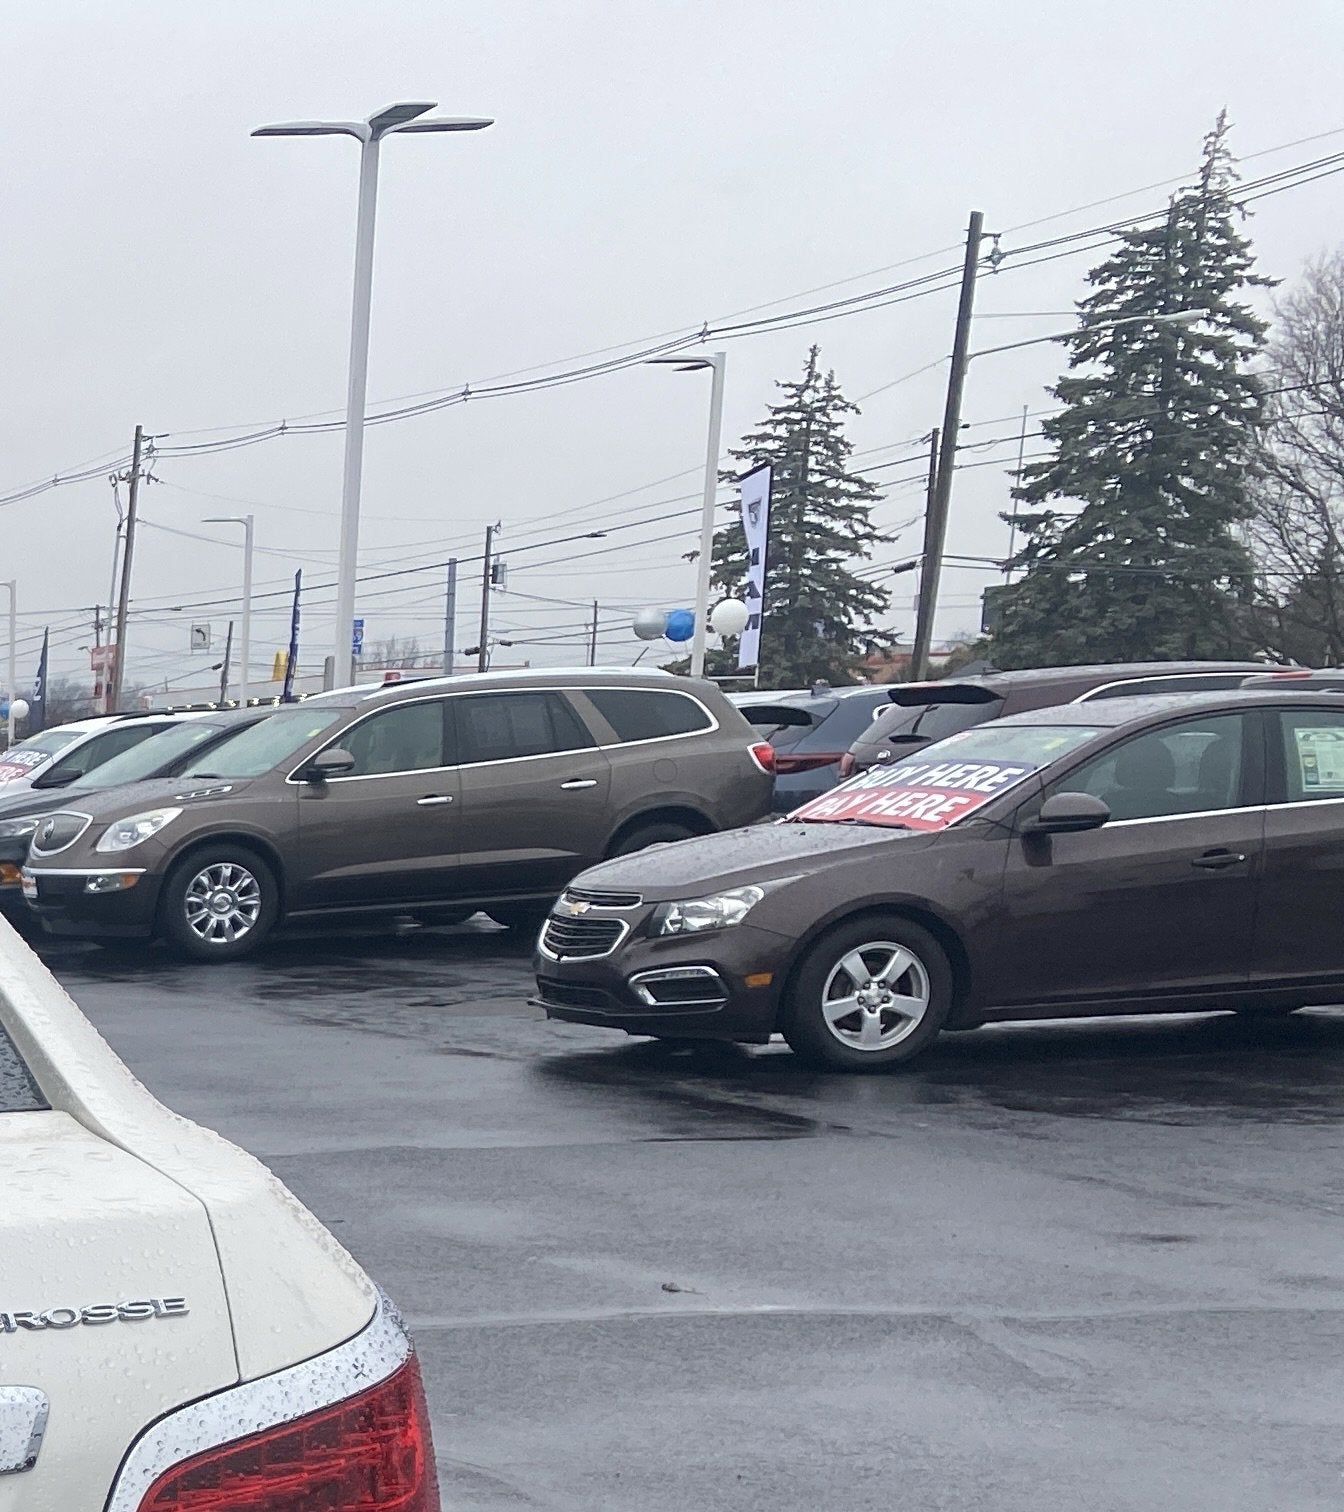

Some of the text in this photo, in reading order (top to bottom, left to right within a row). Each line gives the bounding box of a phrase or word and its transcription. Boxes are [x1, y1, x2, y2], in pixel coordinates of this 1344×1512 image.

[842, 763, 1025, 792] BUY HERE
[805, 791, 970, 822] PAY HERE
